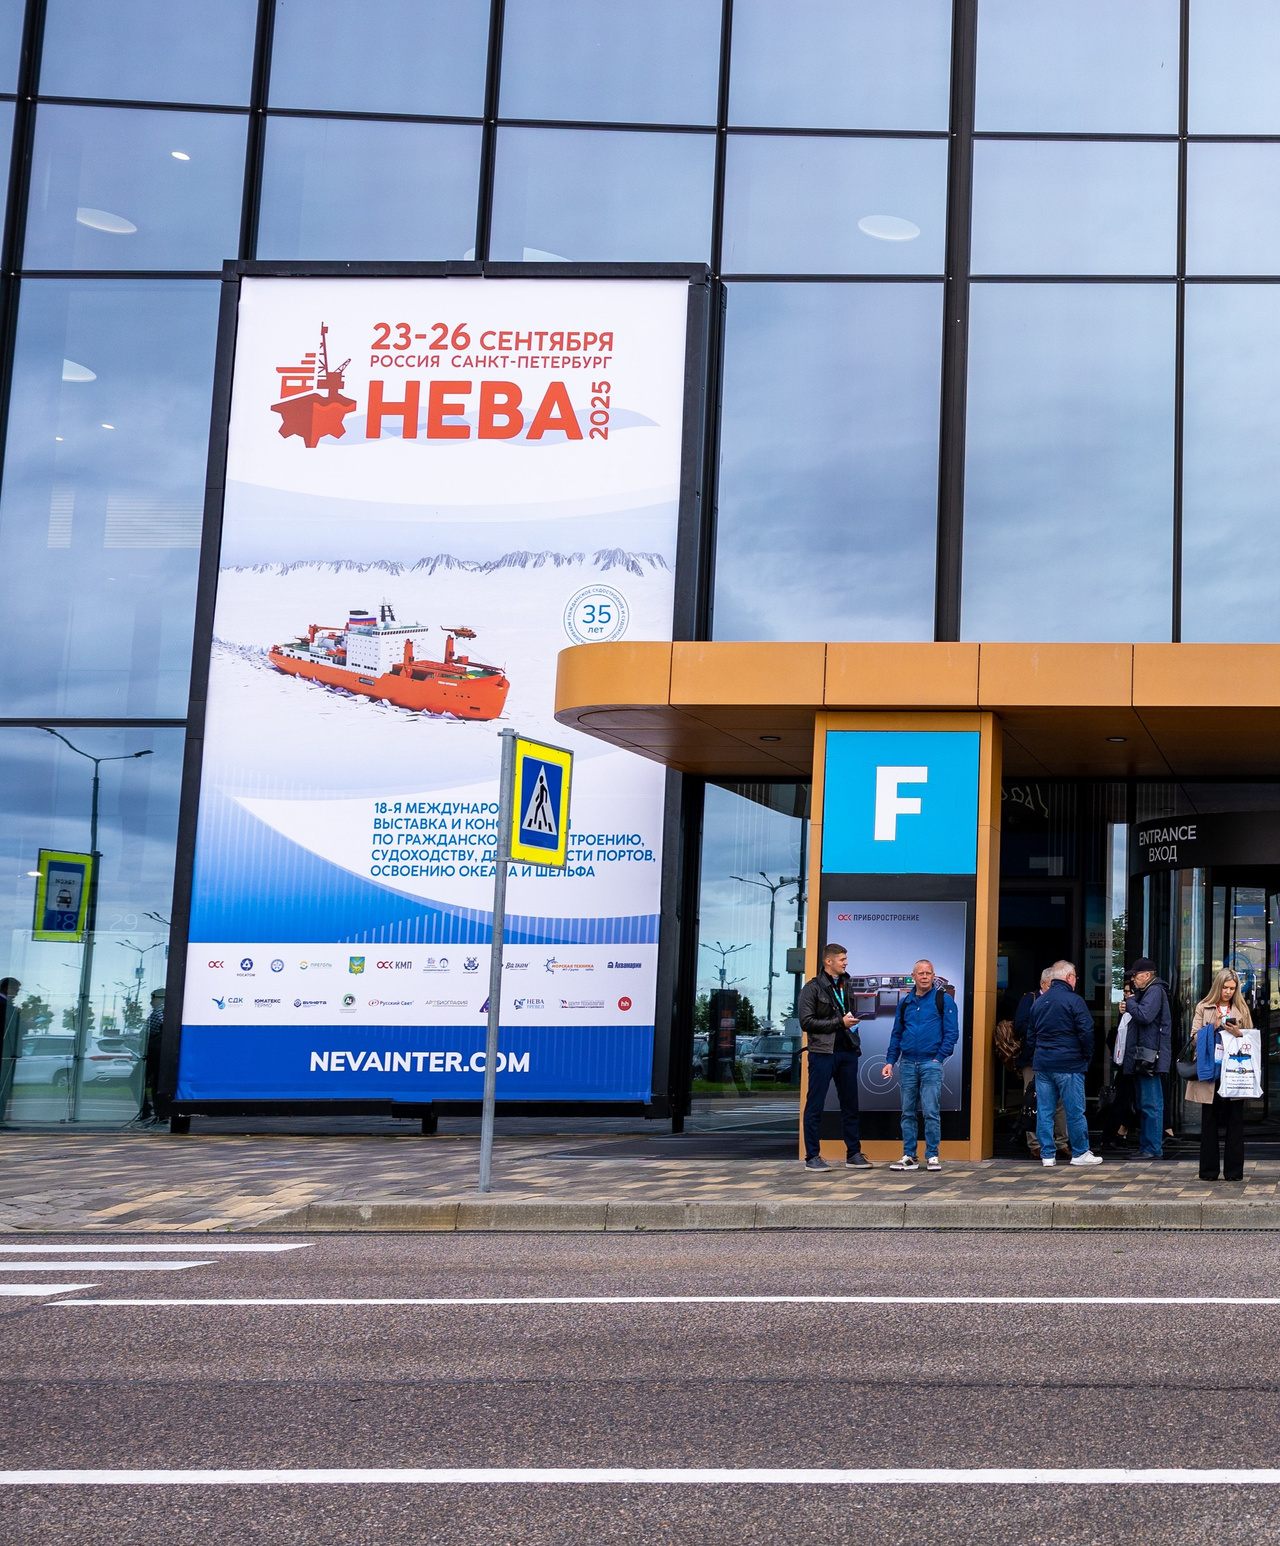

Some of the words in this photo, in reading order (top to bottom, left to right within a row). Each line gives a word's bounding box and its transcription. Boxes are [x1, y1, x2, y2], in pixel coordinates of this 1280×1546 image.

[371, 322, 471, 351] 23-26
[480, 331, 614, 352] СЕНТЯБРЯ
[370, 355, 440, 368] РОССИЯ
[451, 355, 612, 369] САНКТ-ПЕТЕРБУРГ
[365, 380, 584, 440] НЕВА
[589, 380, 611, 440] 2025
[582, 604, 611, 624] 35
[374, 802, 402, 814] 18-Я
[405, 802, 500, 815] МЕЖДУНАРО
[873, 765, 929, 841] F
[373, 818, 448, 830] ВЫСТАВКА
[451, 818, 461, 830] И
[372, 834, 394, 845] ПО
[397, 833, 499, 847] ГРАЖДАНСКО
[570, 834, 645, 847] ТРОЕНИЮ,
[1138, 824, 1197, 846] ENTRANCE
[371, 849, 478, 862] СУДОХОДСТВУ,
[596, 850, 656, 862] ПОРТОВ,
[1148, 843, 1178, 864] ВХОД
[370, 865, 456, 877] ОСВОЕНИЮ
[459, 865, 518, 877] ОКЕАА
[521, 866, 532, 877] И
[535, 865, 595, 877] ШЕЛЬФА
[110, 914, 138, 931] 29
[208, 960, 225, 969] ОСК
[376, 960, 394, 969] ОСК
[395, 961, 412, 969] КМП
[310, 1051, 530, 1073] NEVAINTER.COM
